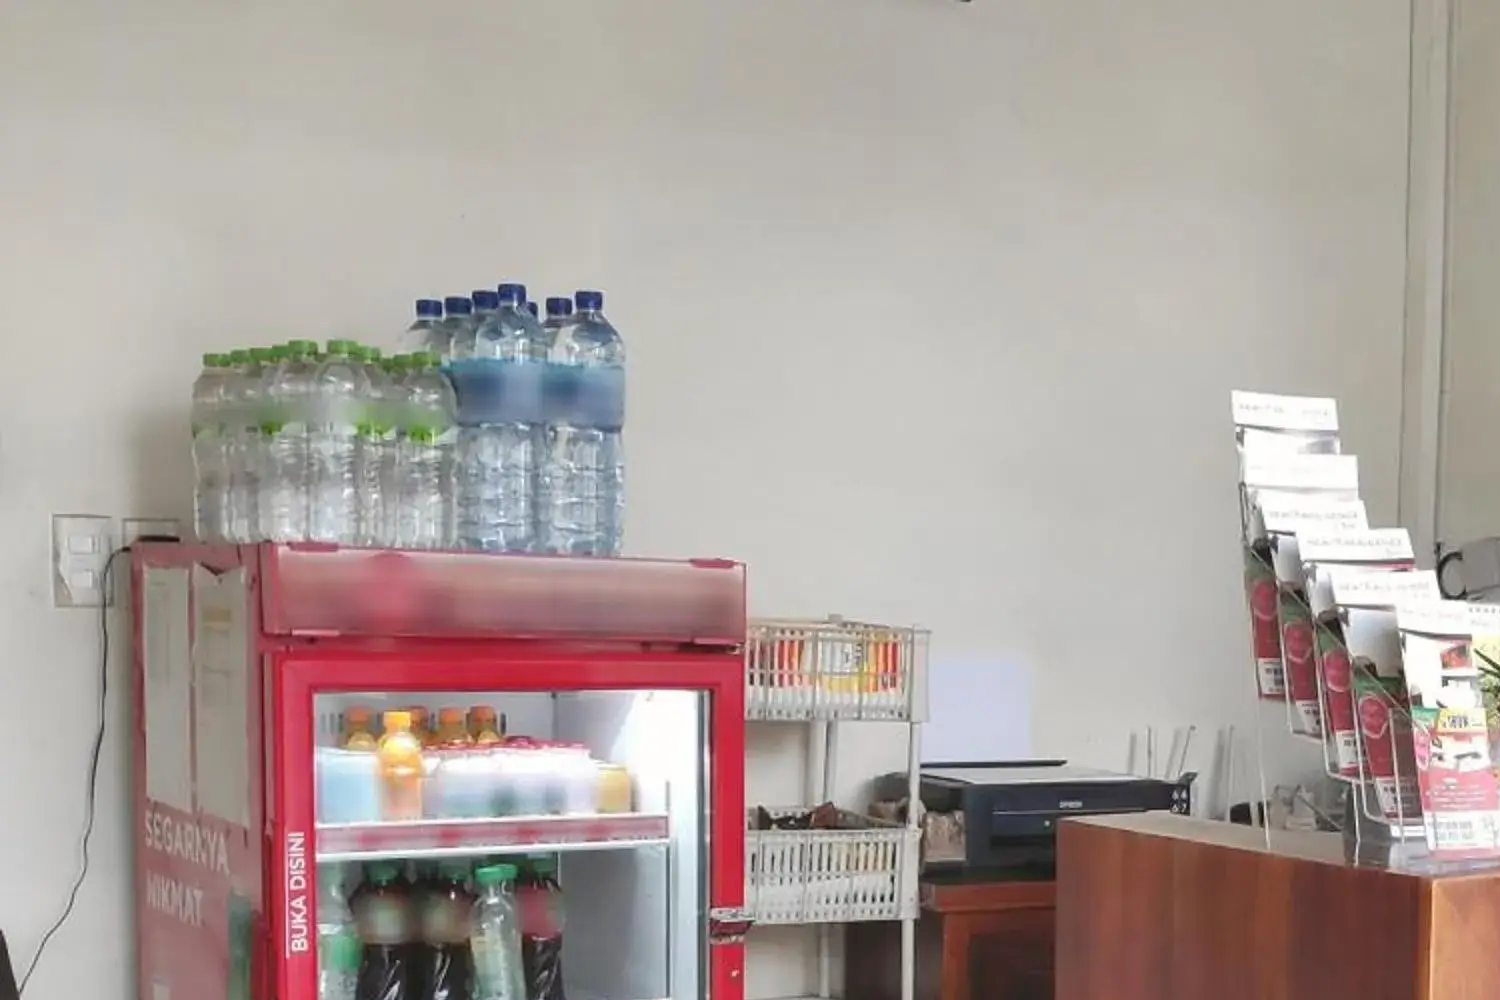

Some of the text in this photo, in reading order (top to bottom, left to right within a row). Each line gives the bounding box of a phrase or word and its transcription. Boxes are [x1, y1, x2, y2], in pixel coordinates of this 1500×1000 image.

[144, 810, 230, 877] SEGARNYA
[146, 870, 204, 927] NIKMAT
[289, 831, 309, 953] BUKA DISINI
